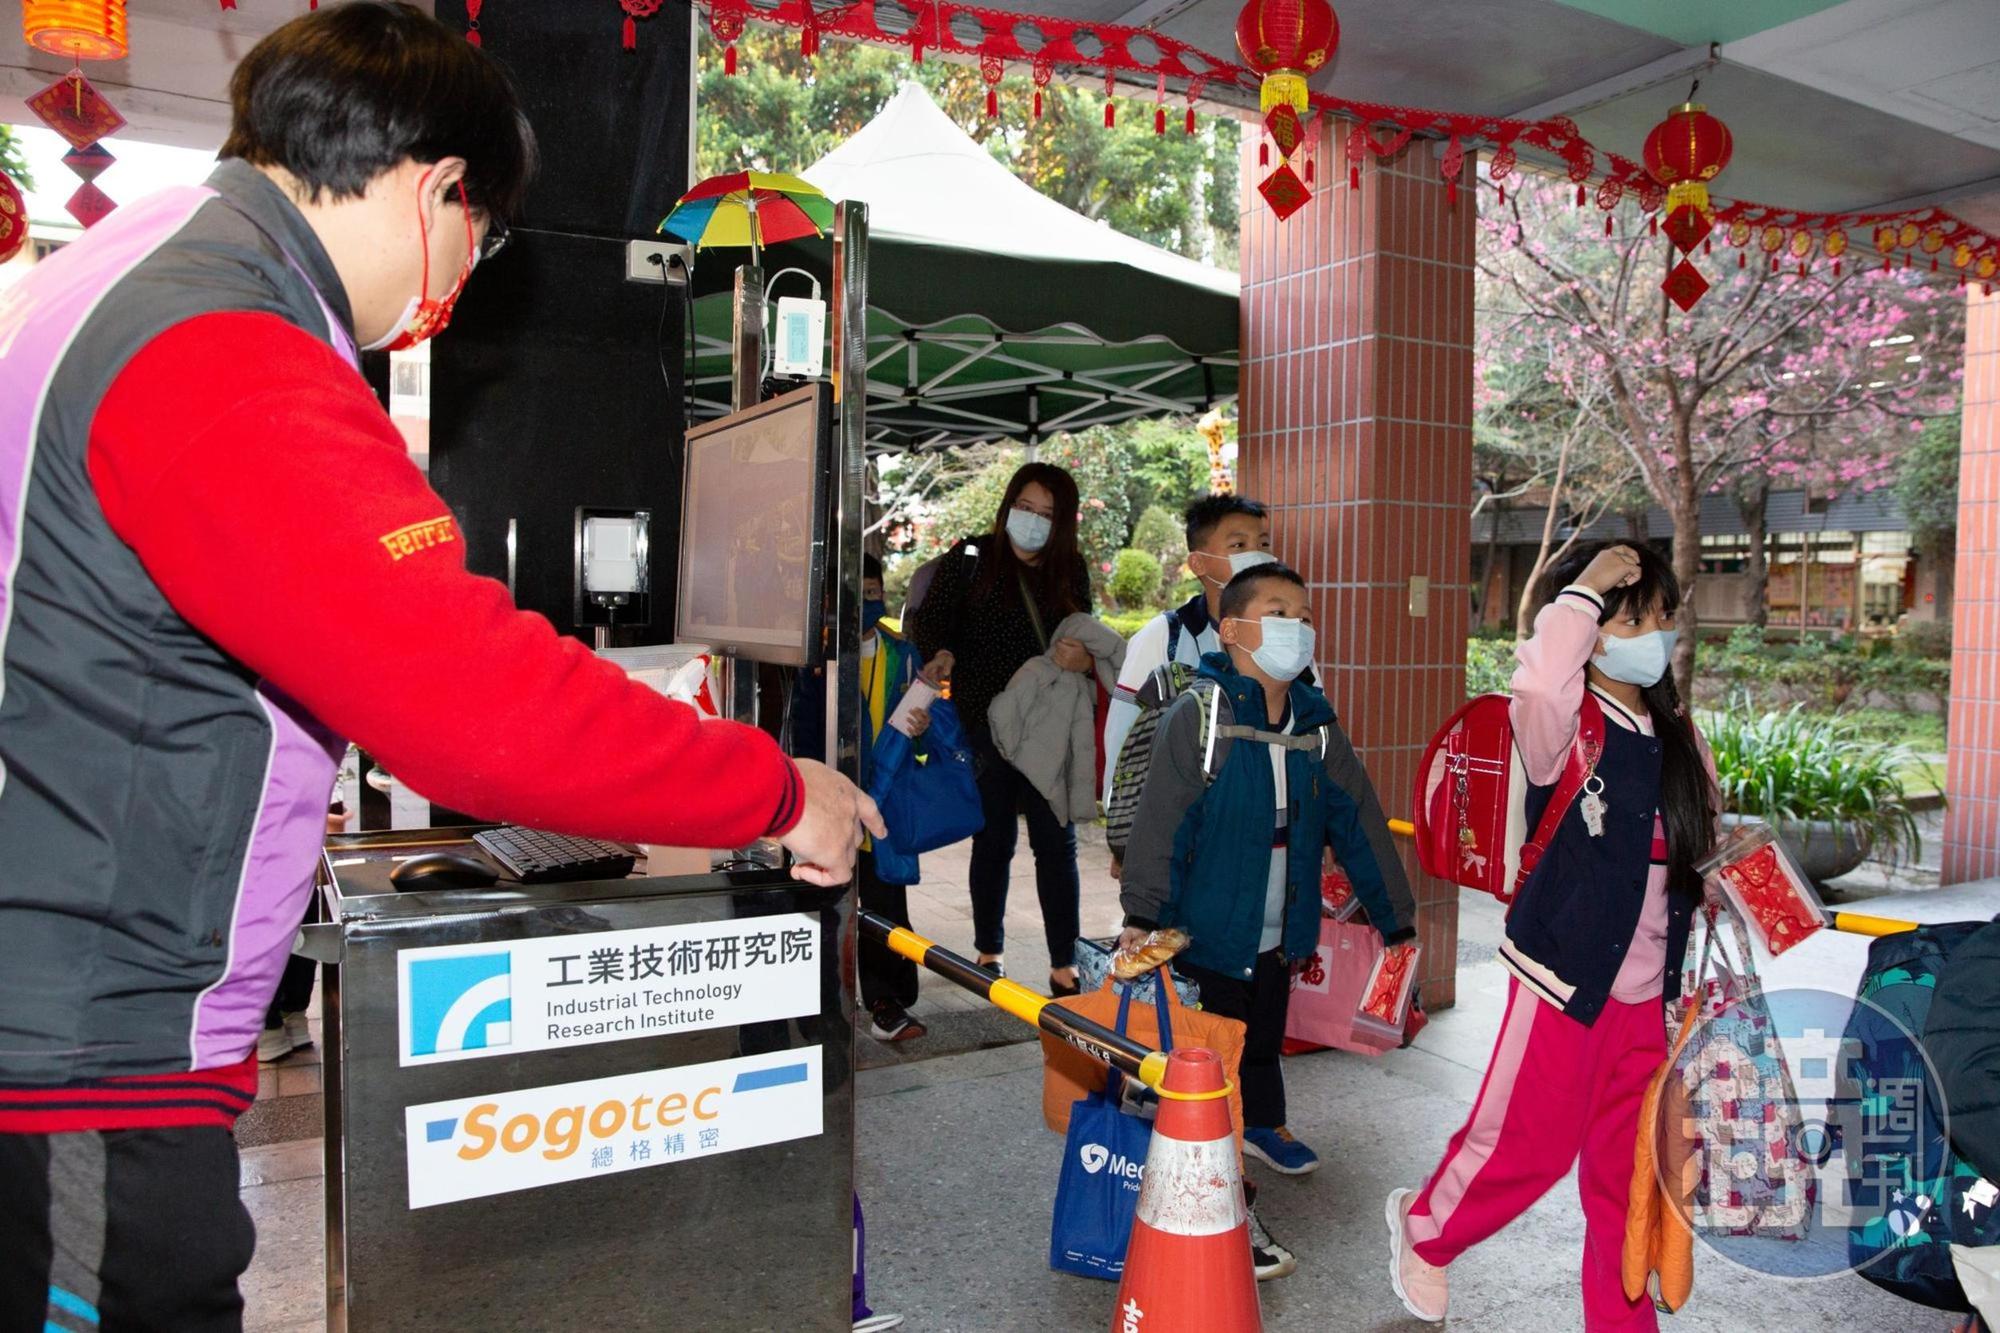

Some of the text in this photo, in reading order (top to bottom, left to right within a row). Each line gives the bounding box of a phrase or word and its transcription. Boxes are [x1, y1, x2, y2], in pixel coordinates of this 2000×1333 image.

[546, 927, 813, 988] 工業技術研究院
[547, 983, 743, 1017] Industrial Technology
[548, 1007, 715, 1040] Research Institute
[457, 1086, 722, 1161] Sogotec
[591, 1127, 720, 1169] 總格精密
[1123, 1180, 1141, 1193] Prid
